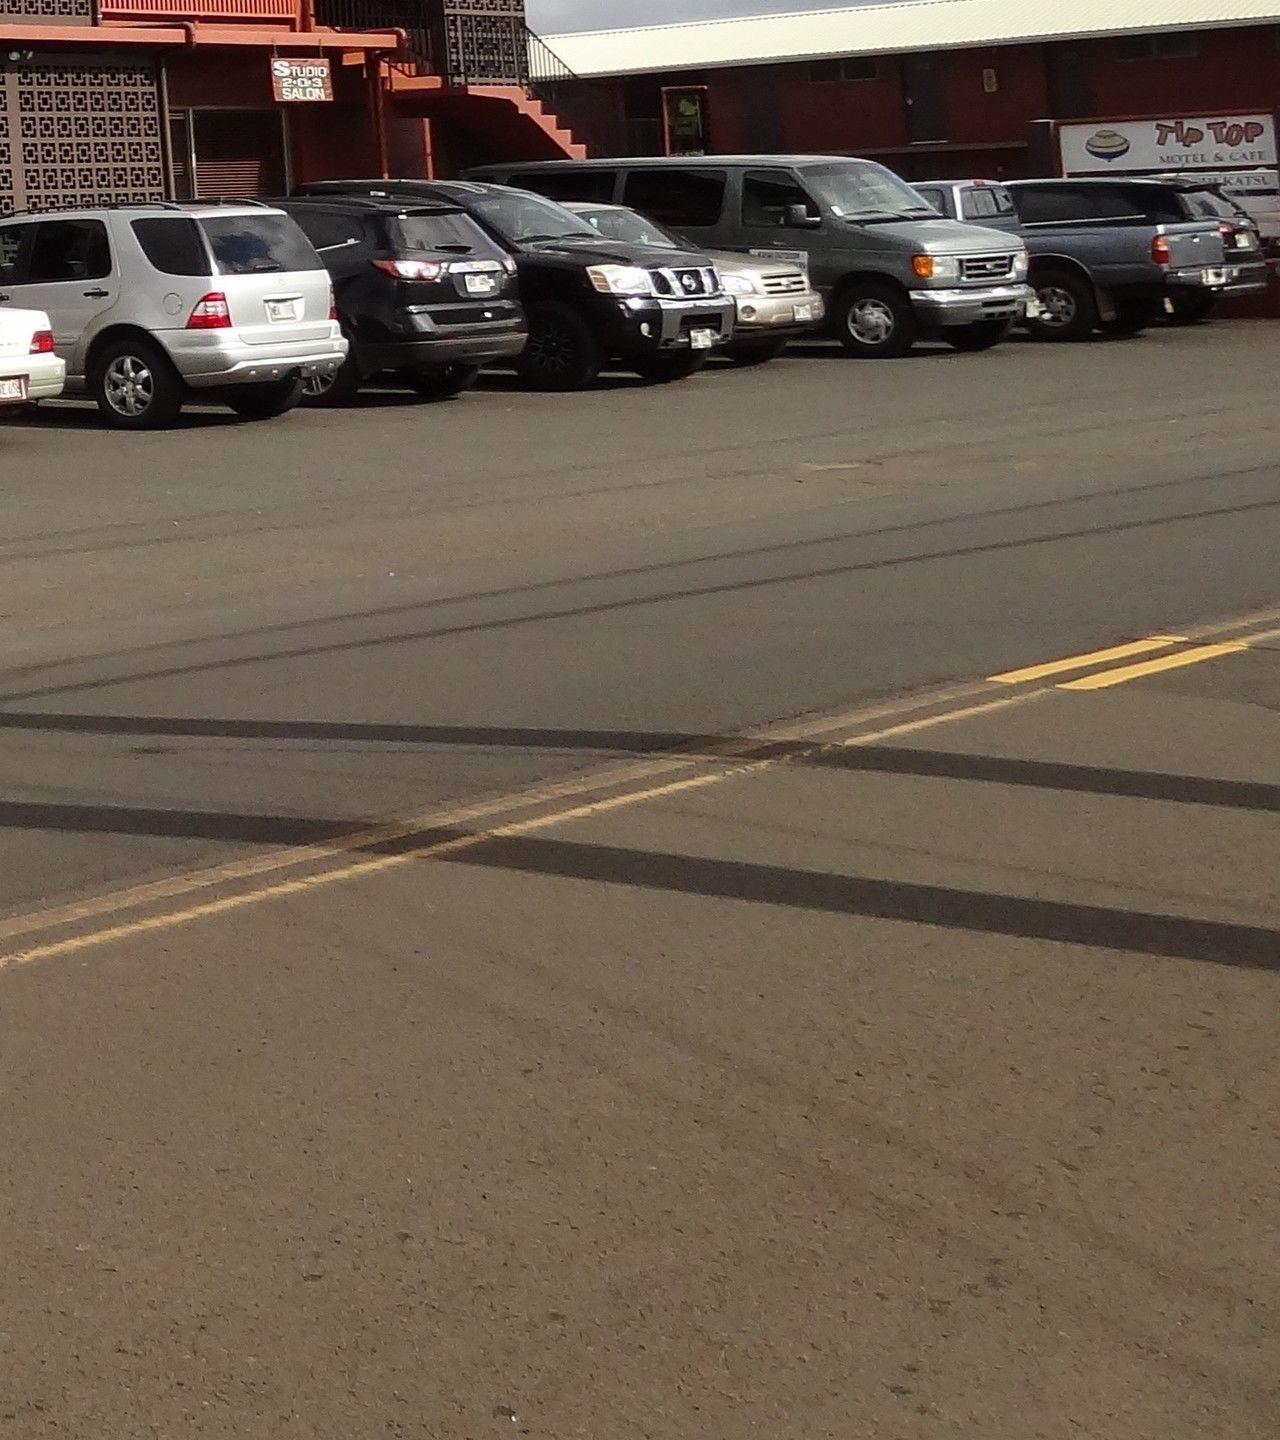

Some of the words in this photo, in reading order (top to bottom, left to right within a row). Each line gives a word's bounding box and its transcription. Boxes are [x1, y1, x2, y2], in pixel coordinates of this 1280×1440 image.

[273, 61, 327, 77] STUDIO
[282, 88, 325, 100] SALON
[1155, 121, 1204, 147] TIP
[1206, 121, 1264, 147] TOP
[1159, 152, 1207, 164] MOTEL
[1229, 151, 1265, 162] CAFE
